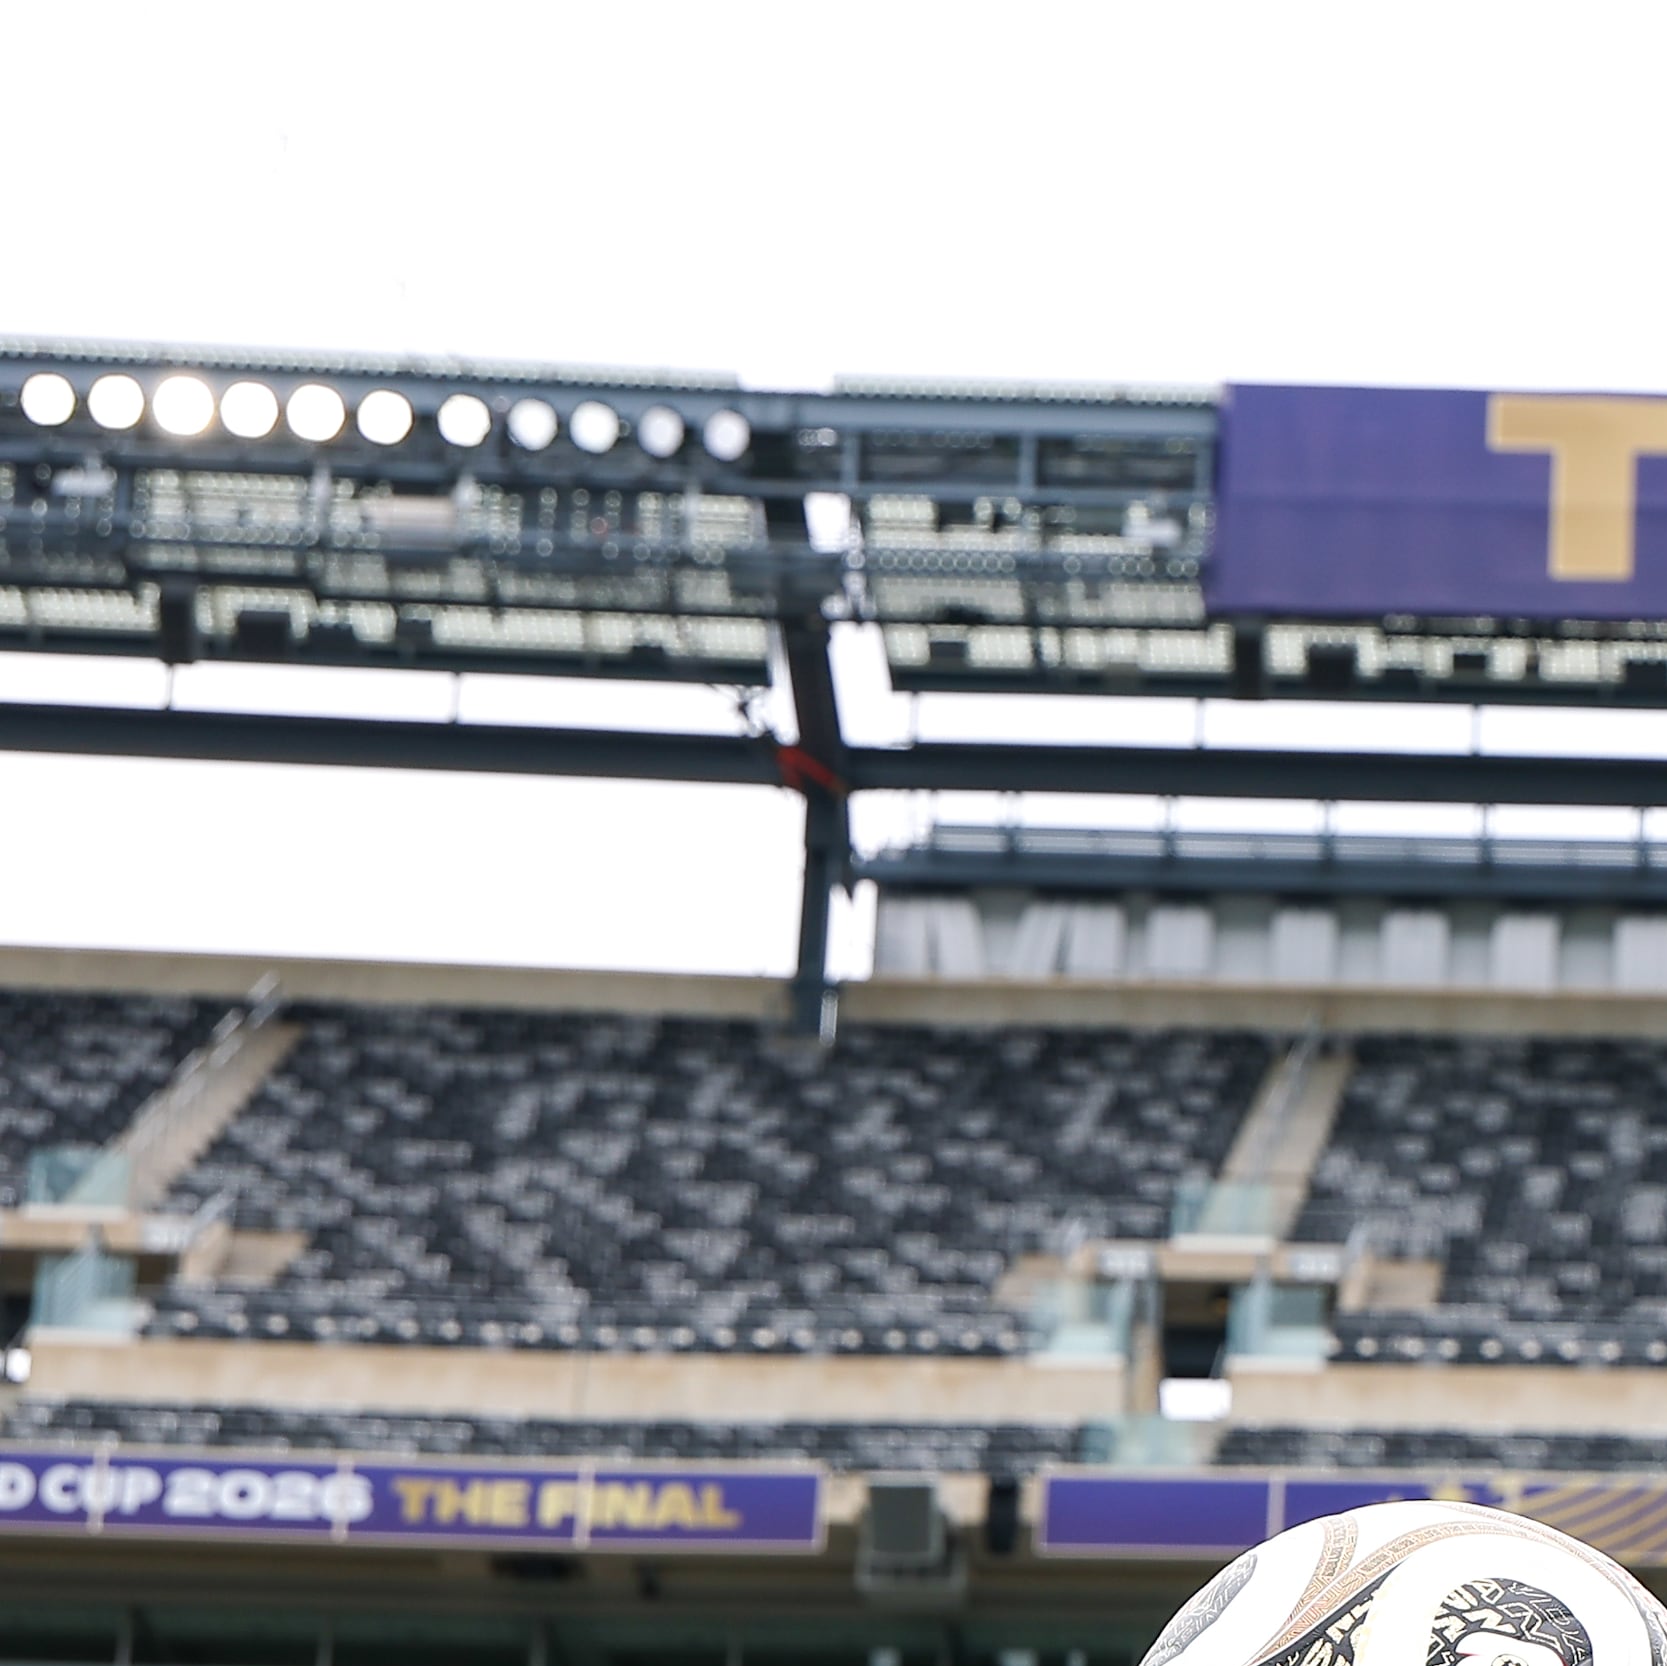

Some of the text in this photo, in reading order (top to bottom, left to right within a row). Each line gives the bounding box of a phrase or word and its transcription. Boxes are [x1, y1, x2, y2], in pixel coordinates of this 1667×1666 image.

[38, 1463, 164, 1515] CUP
[163, 1467, 374, 1523] 2026
[392, 1477, 531, 1528] THE
[536, 1479, 742, 1531] FINAL
